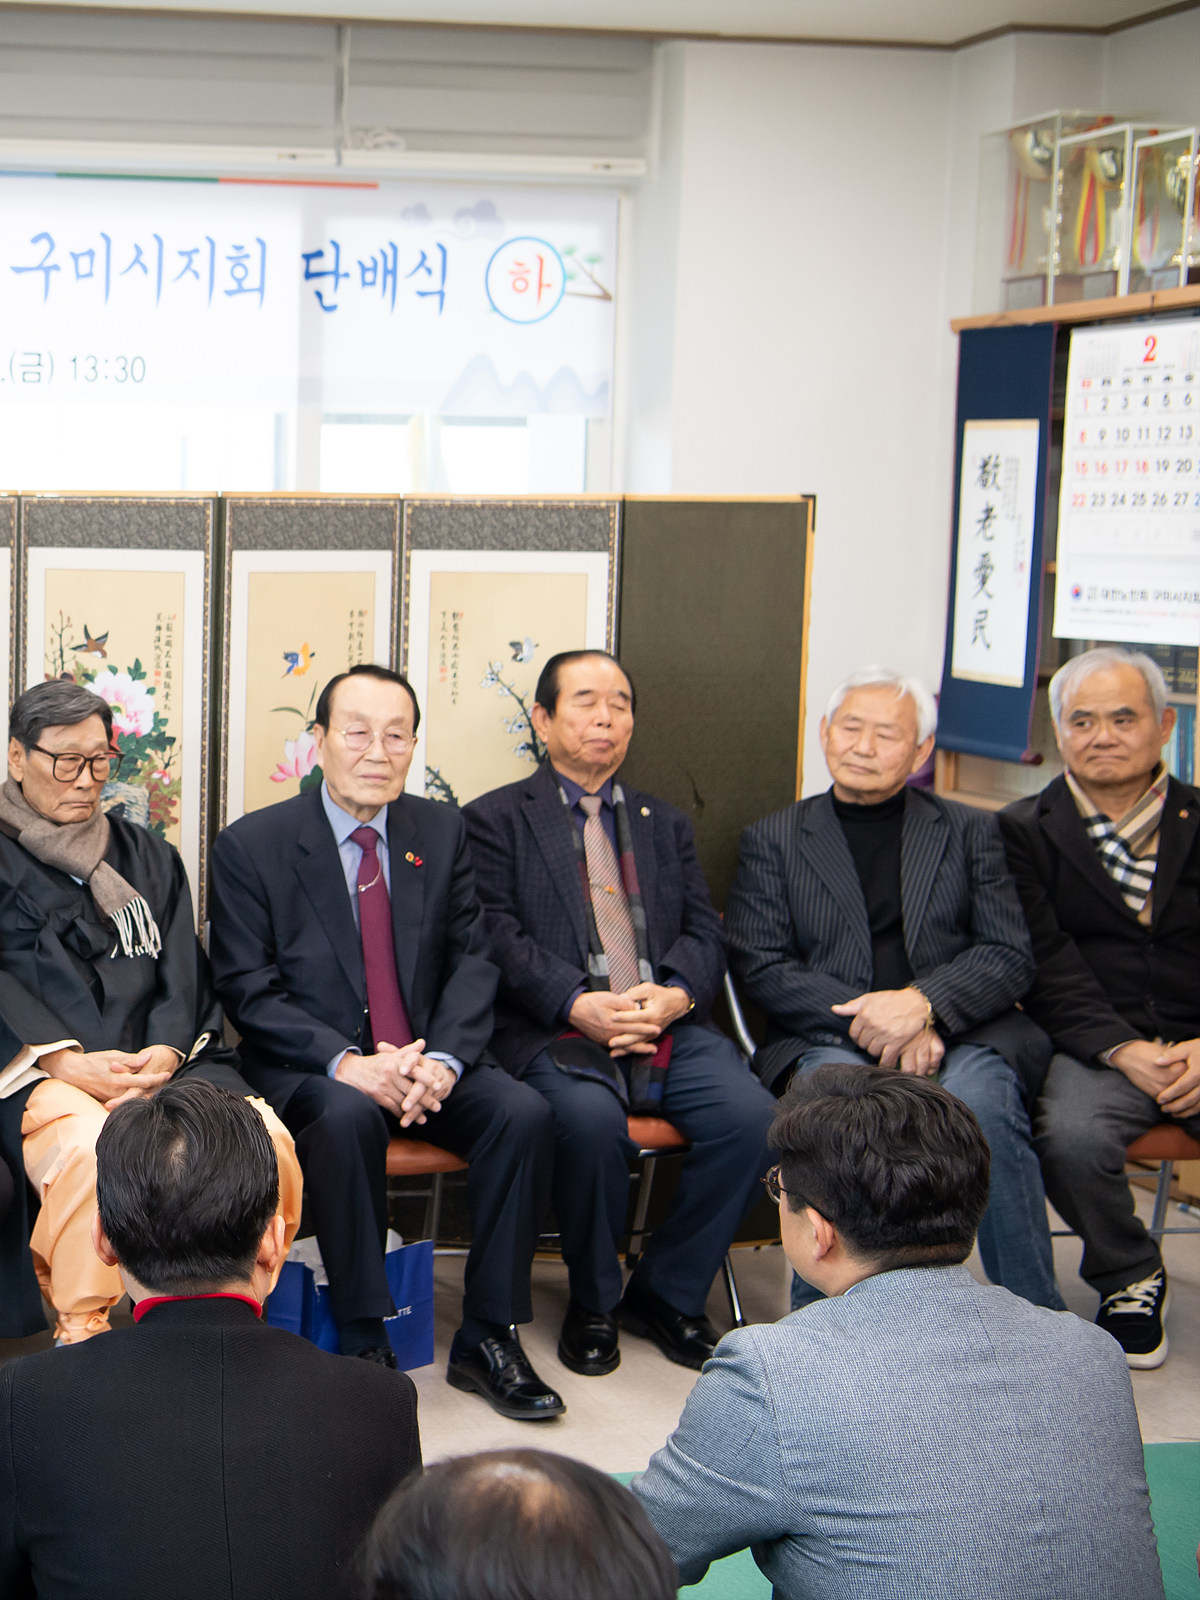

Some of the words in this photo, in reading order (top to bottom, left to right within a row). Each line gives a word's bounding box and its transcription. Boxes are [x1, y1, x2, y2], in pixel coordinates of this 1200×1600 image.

[9, 231, 267, 306] 구미시지회
[300, 239, 449, 315] 단배식
[507, 253, 554, 307] 하
[1142, 334, 1158, 363] 2
[70, 354, 146, 384] 13:30
[1102, 395, 1109, 411] 2
[1122, 394, 1129, 410] 3
[1142, 393, 1150, 408] 4
[1163, 391, 1170, 407] 5
[1184, 391, 1192, 406] 6
[1098, 427, 1106, 441] 9
[1116, 427, 1130, 441] 10
[1138, 427, 1150, 440] 11
[1158, 426, 1172, 440] 12
[1180, 424, 1193, 439] 13
[1075, 460, 1088, 475] 15
[1095, 460, 1108, 475] 16
[1115, 459, 1128, 474] 17
[1136, 459, 1149, 474] 18
[1156, 458, 1170, 472] 19
[1176, 458, 1192, 473] 20
[1072, 492, 1087, 507] 22
[1091, 492, 1106, 507] 23
[1111, 492, 1127, 507] 24
[1132, 492, 1147, 507] 25
[1152, 491, 1168, 506] 26
[1174, 491, 1189, 506] 27
